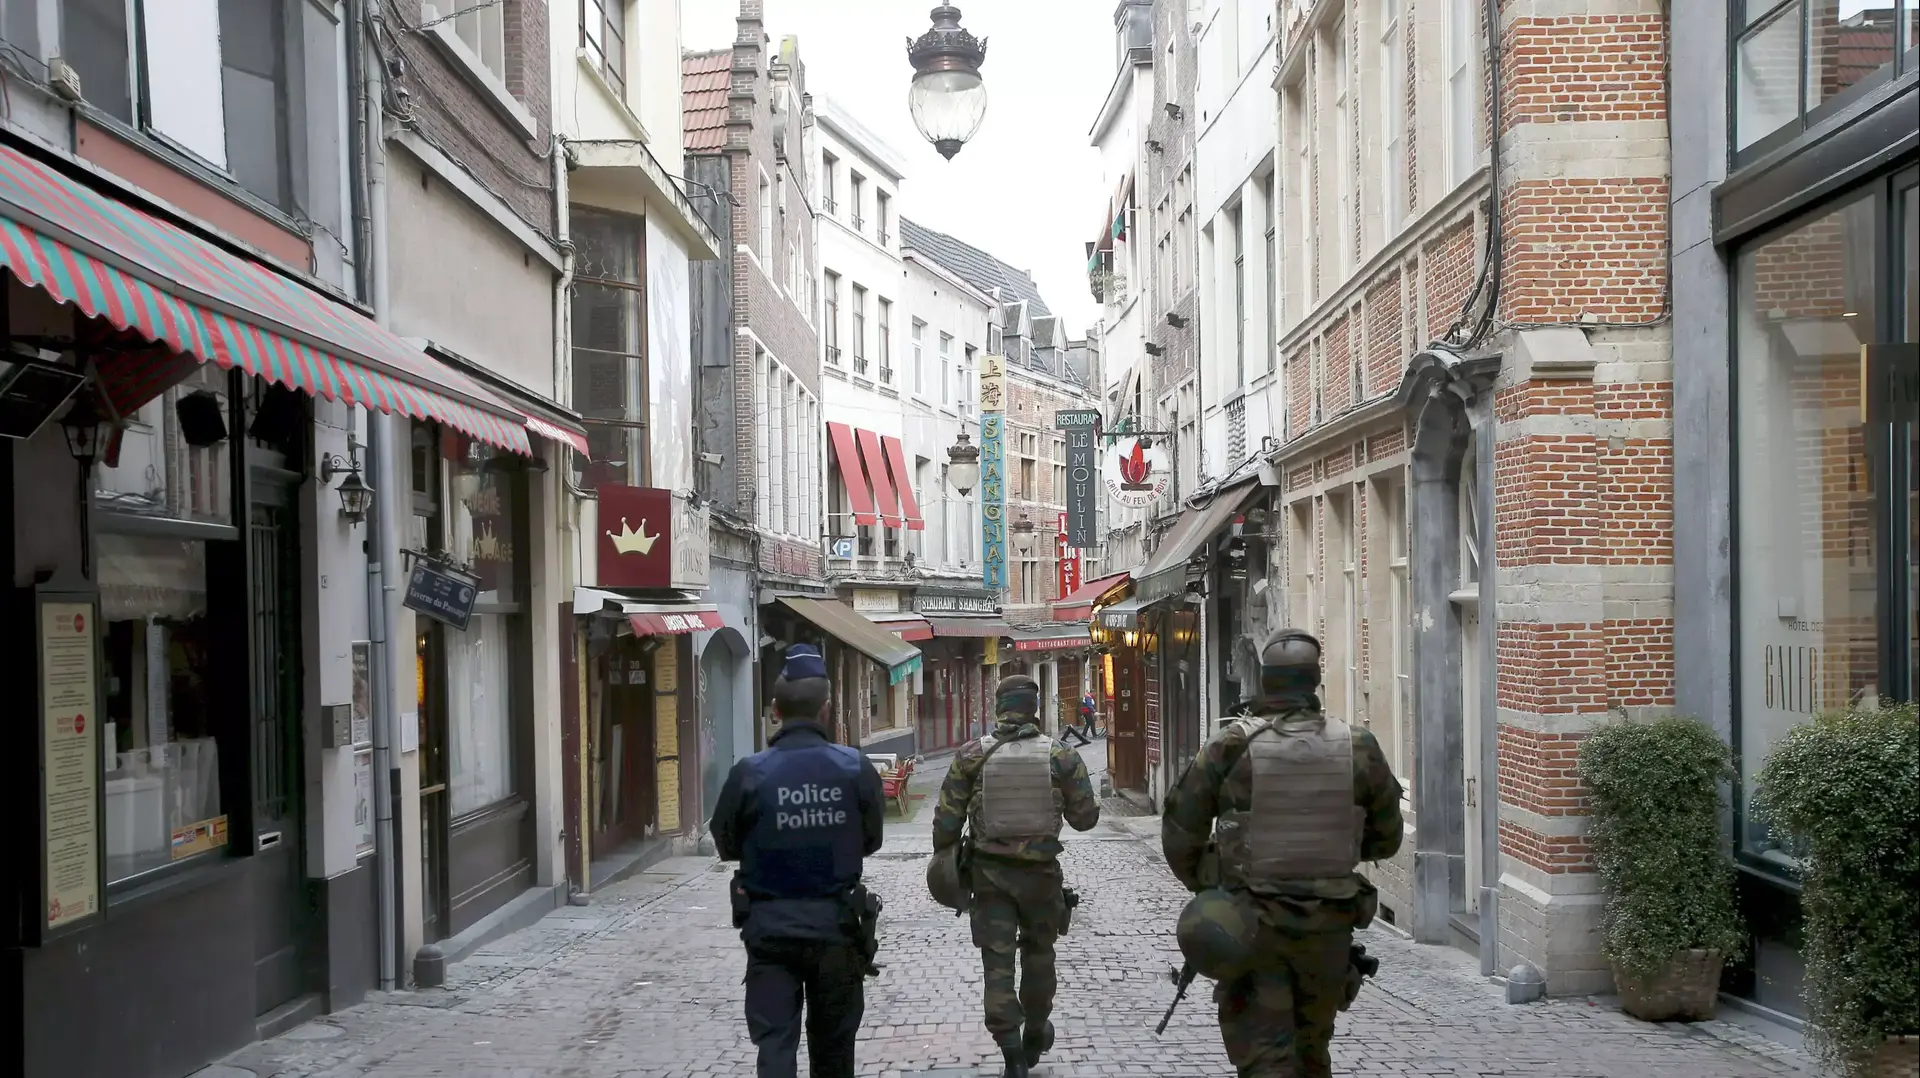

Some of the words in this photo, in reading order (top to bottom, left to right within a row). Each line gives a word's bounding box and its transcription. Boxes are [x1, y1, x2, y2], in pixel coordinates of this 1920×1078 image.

[979, 359, 1002, 406] 上海
[1056, 413, 1098, 426] RESTAURAN
[983, 416, 1002, 585] SHANGHAI
[1072, 452, 1089, 544] MOULIN
[1106, 479, 1121, 499] GRILL
[1122, 494, 1132, 504] AU
[1133, 496, 1147, 505] FEU
[1147, 492, 1157, 501] DE
[1155, 478, 1168, 494] BOIS
[840, 541, 851, 556] P
[680, 547, 704, 576] HOUSE
[409, 587, 433, 604] Taverne
[433, 598, 442, 608] du
[958, 597, 996, 613] SHANGHAI
[777, 783, 843, 806] Police
[776, 806, 847, 831] Politie
